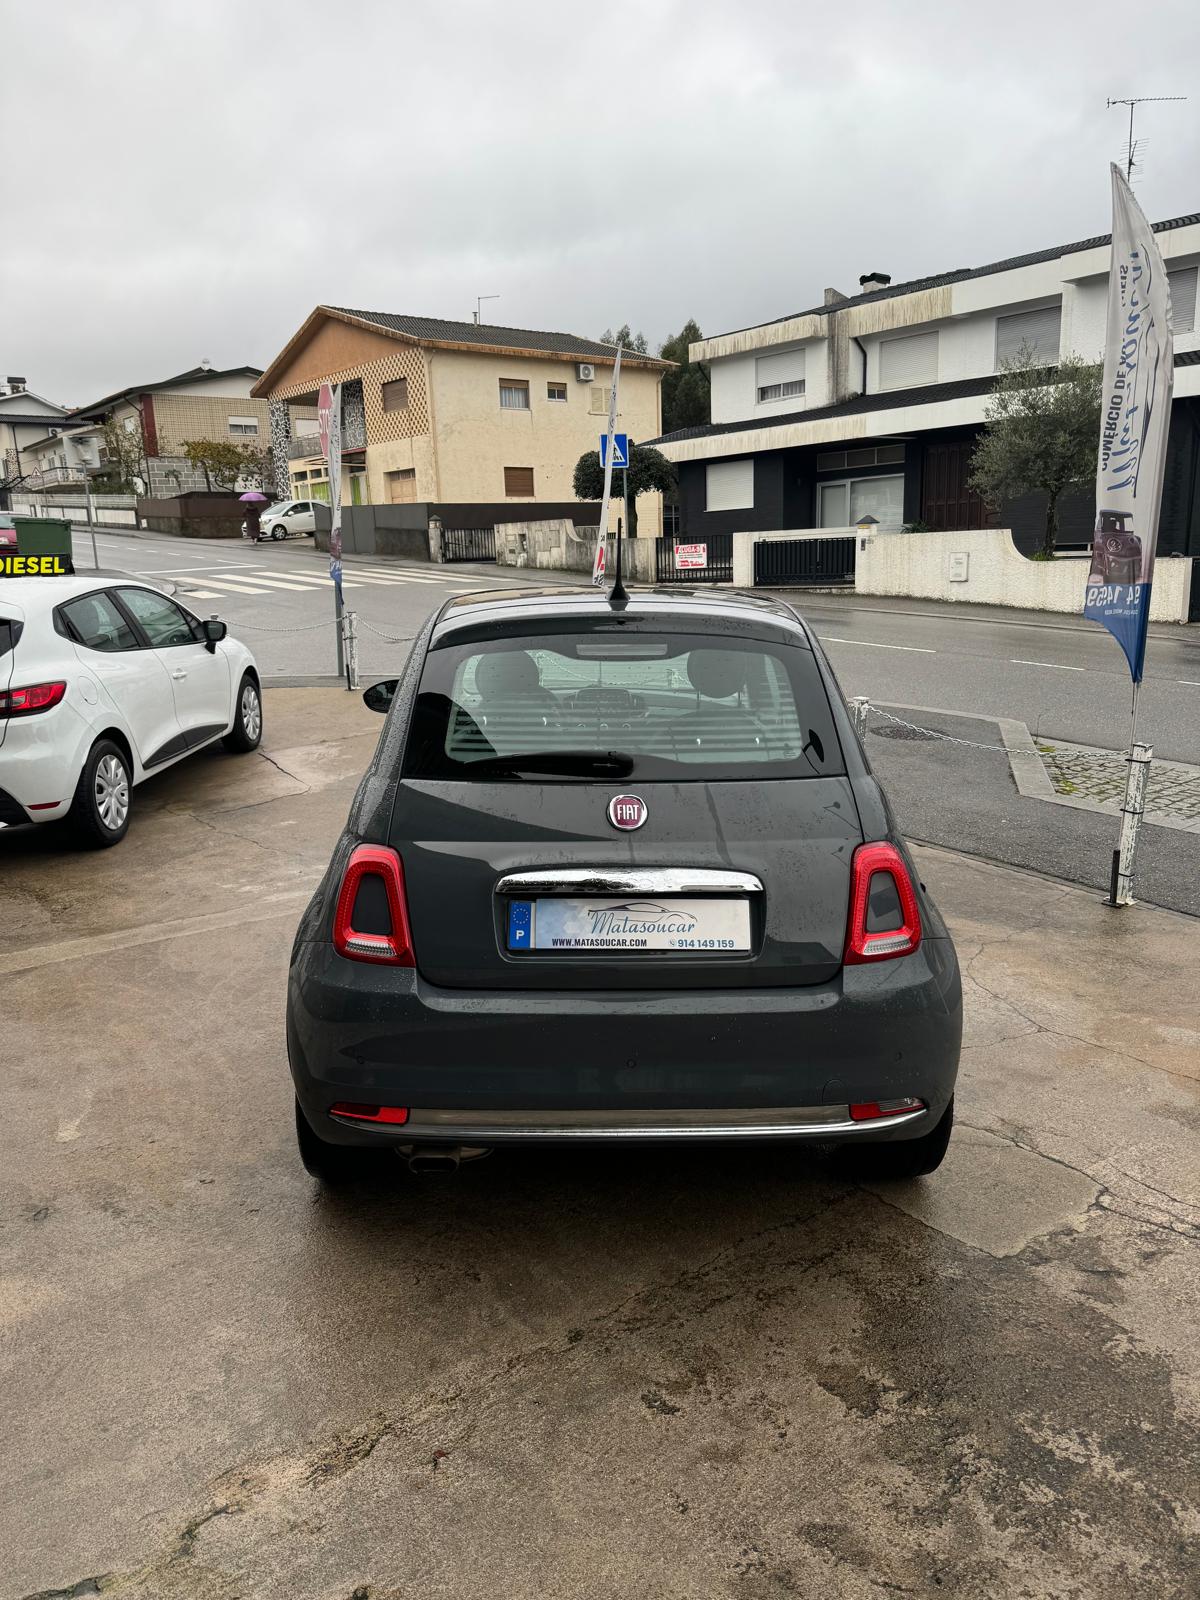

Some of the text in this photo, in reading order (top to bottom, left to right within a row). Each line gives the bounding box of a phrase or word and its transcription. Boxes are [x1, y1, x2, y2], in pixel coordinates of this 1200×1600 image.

[617, 804, 640, 820] FIAT
[590, 911, 695, 936] Matasoucar
[516, 930, 525, 940] P
[552, 938, 647, 947] WWW.MATASOUCAR.COM
[677, 939, 734, 948] 914 149 159
